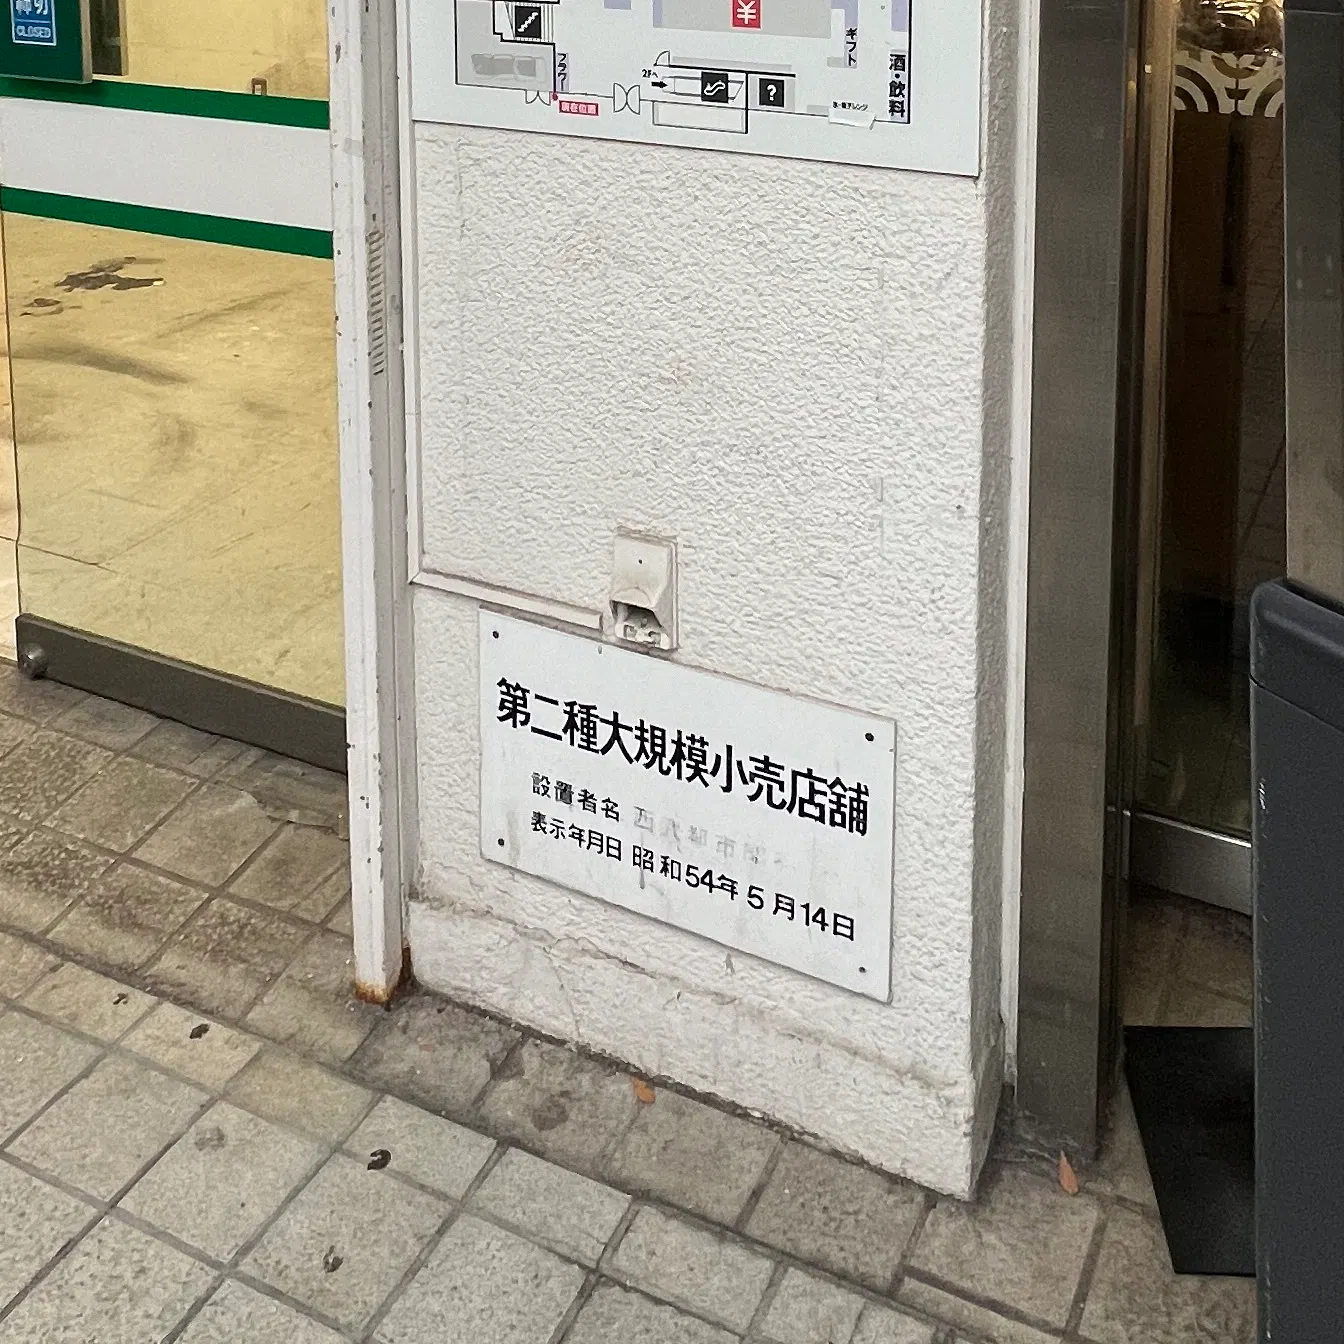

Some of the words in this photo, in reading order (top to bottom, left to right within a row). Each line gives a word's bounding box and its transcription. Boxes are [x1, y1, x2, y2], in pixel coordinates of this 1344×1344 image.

[15, 25, 52, 39] CLOSED
[845, 27, 858, 67] ギフト
[496, 676, 870, 837] 第二種大規模小売店舗
[530, 772, 621, 824] 設置者名
[530, 810, 623, 863] 表示年月日
